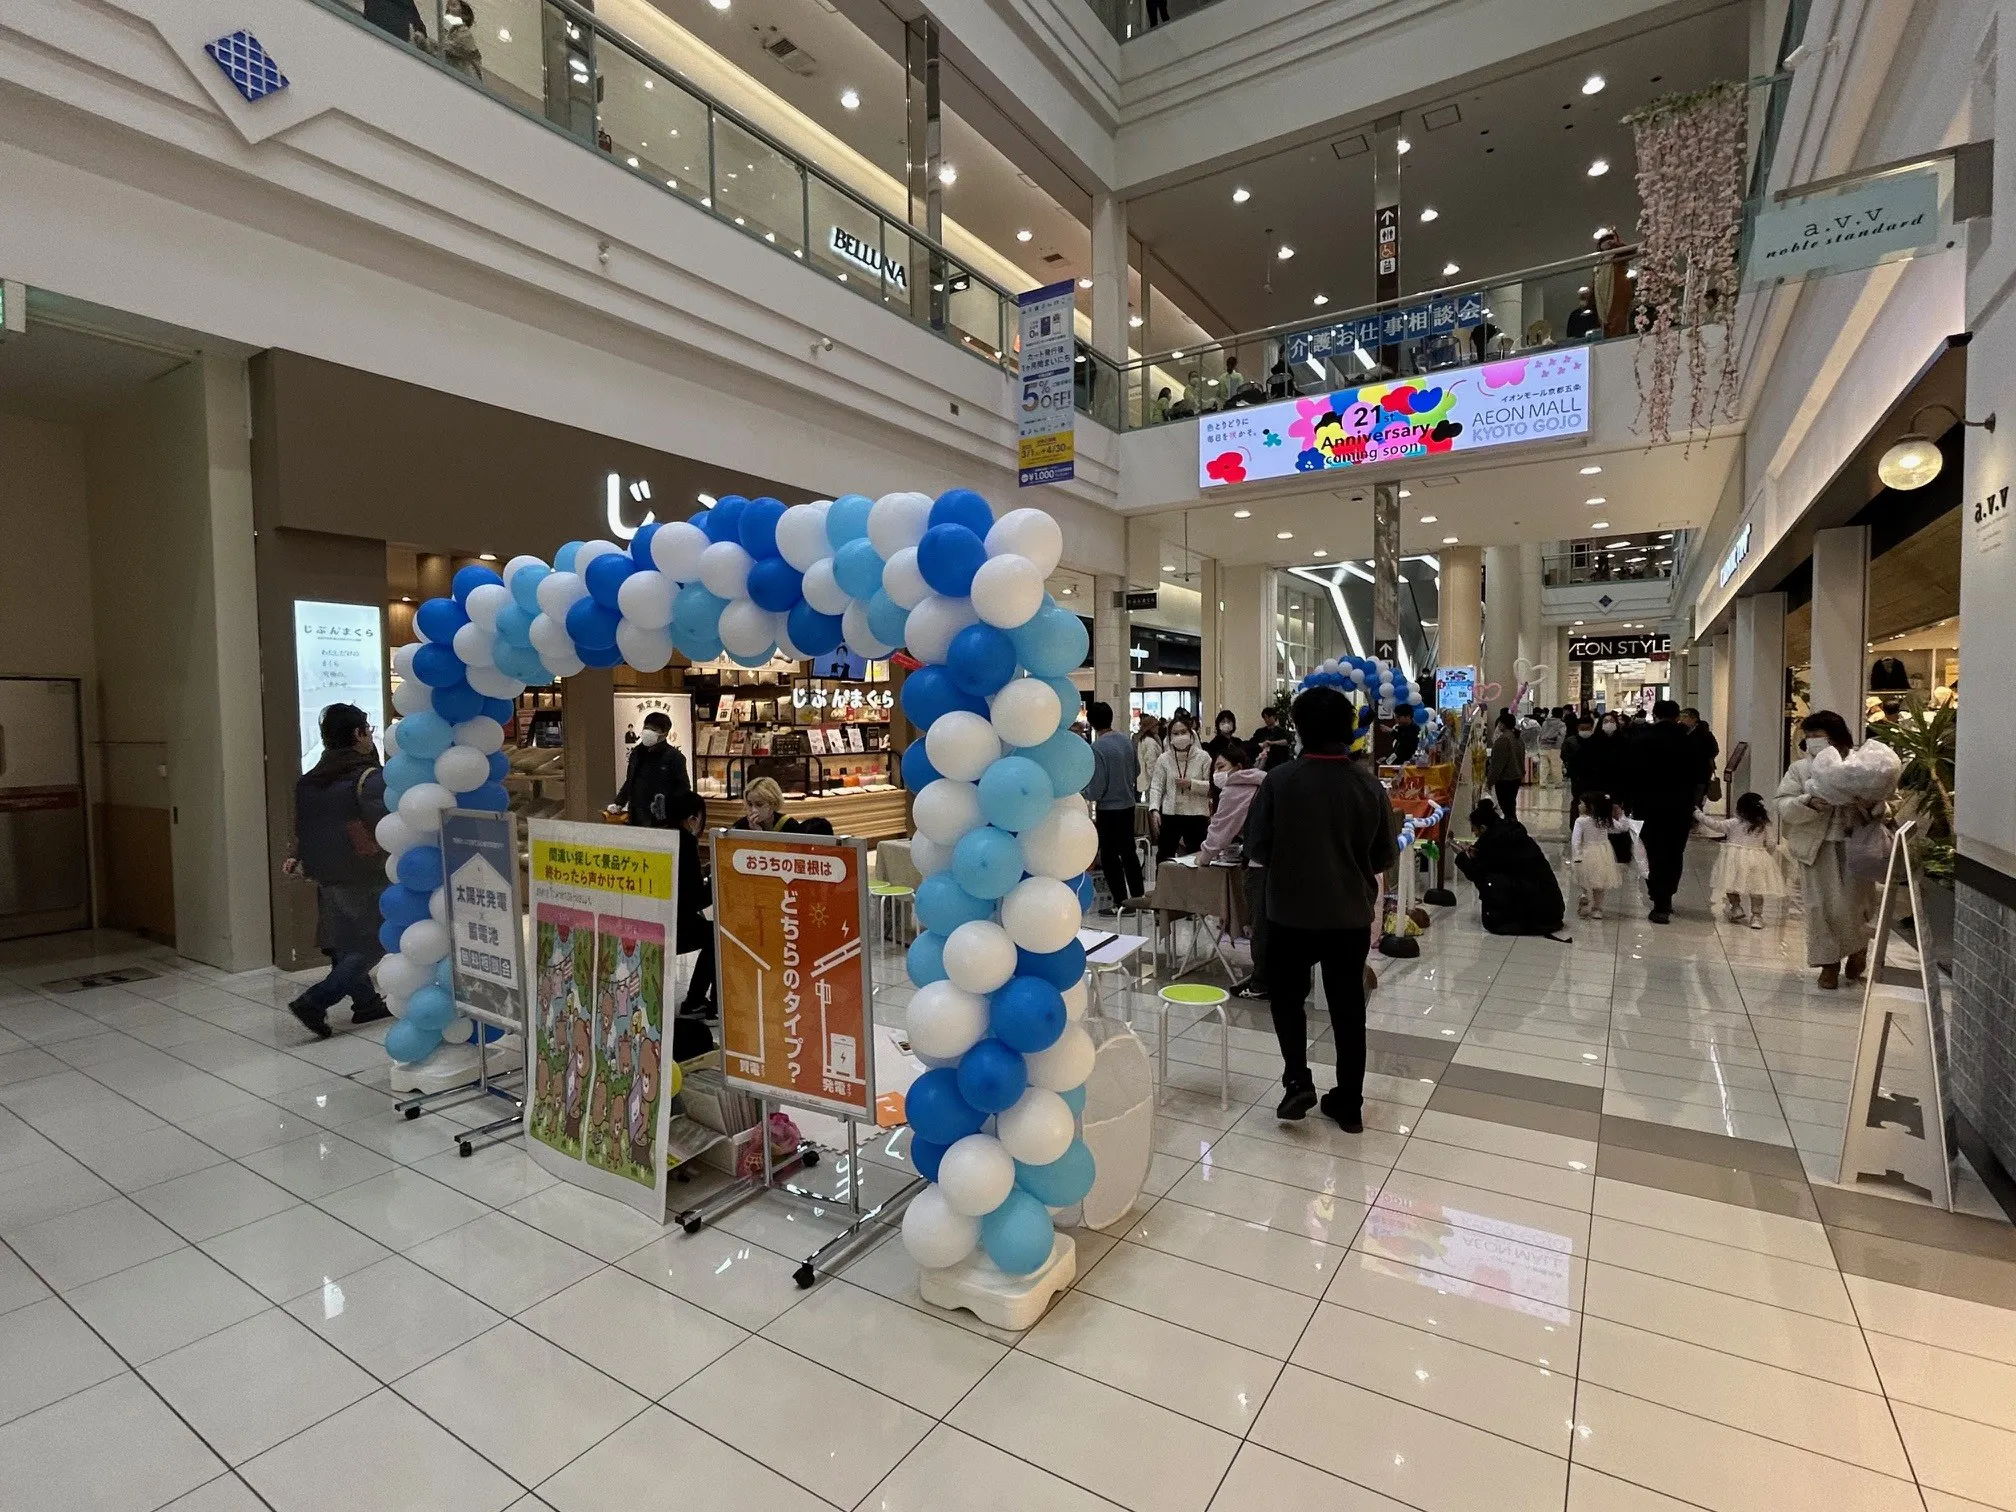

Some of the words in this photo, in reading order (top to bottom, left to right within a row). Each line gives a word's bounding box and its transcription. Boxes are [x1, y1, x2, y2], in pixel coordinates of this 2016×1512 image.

[1804, 207, 1884, 237] a.v.v
[1766, 240, 1819, 259] noble
[1825, 213, 1925, 245] standard
[834, 227, 908, 288] BELLUNA
[1289, 298, 1482, 359] 介護お仕事相談会
[1501, 384, 1582, 403] イオンモール京都五条
[1206, 418, 1250, 432] 色とりどりに
[1472, 405, 1525, 428] AEON
[1528, 397, 1582, 419] MALL
[1321, 423, 1431, 451] Anniversary
[1472, 421, 1528, 442] KYOTO
[1532, 413, 1582, 433] GOJO
[1325, 446, 1378, 466] coming
[1382, 442, 1419, 457] soon
[304, 624, 374, 638] じぶんまくら
[1617, 638, 1671, 655] STYLE
[792, 687, 894, 709] じぶんまくら
[548, 847, 650, 874] 間違い探して景品ゲット
[745, 855, 833, 876] おうちの屋根は
[455, 884, 508, 912] 太陽光発電
[468, 922, 499, 946] 蓄電池
